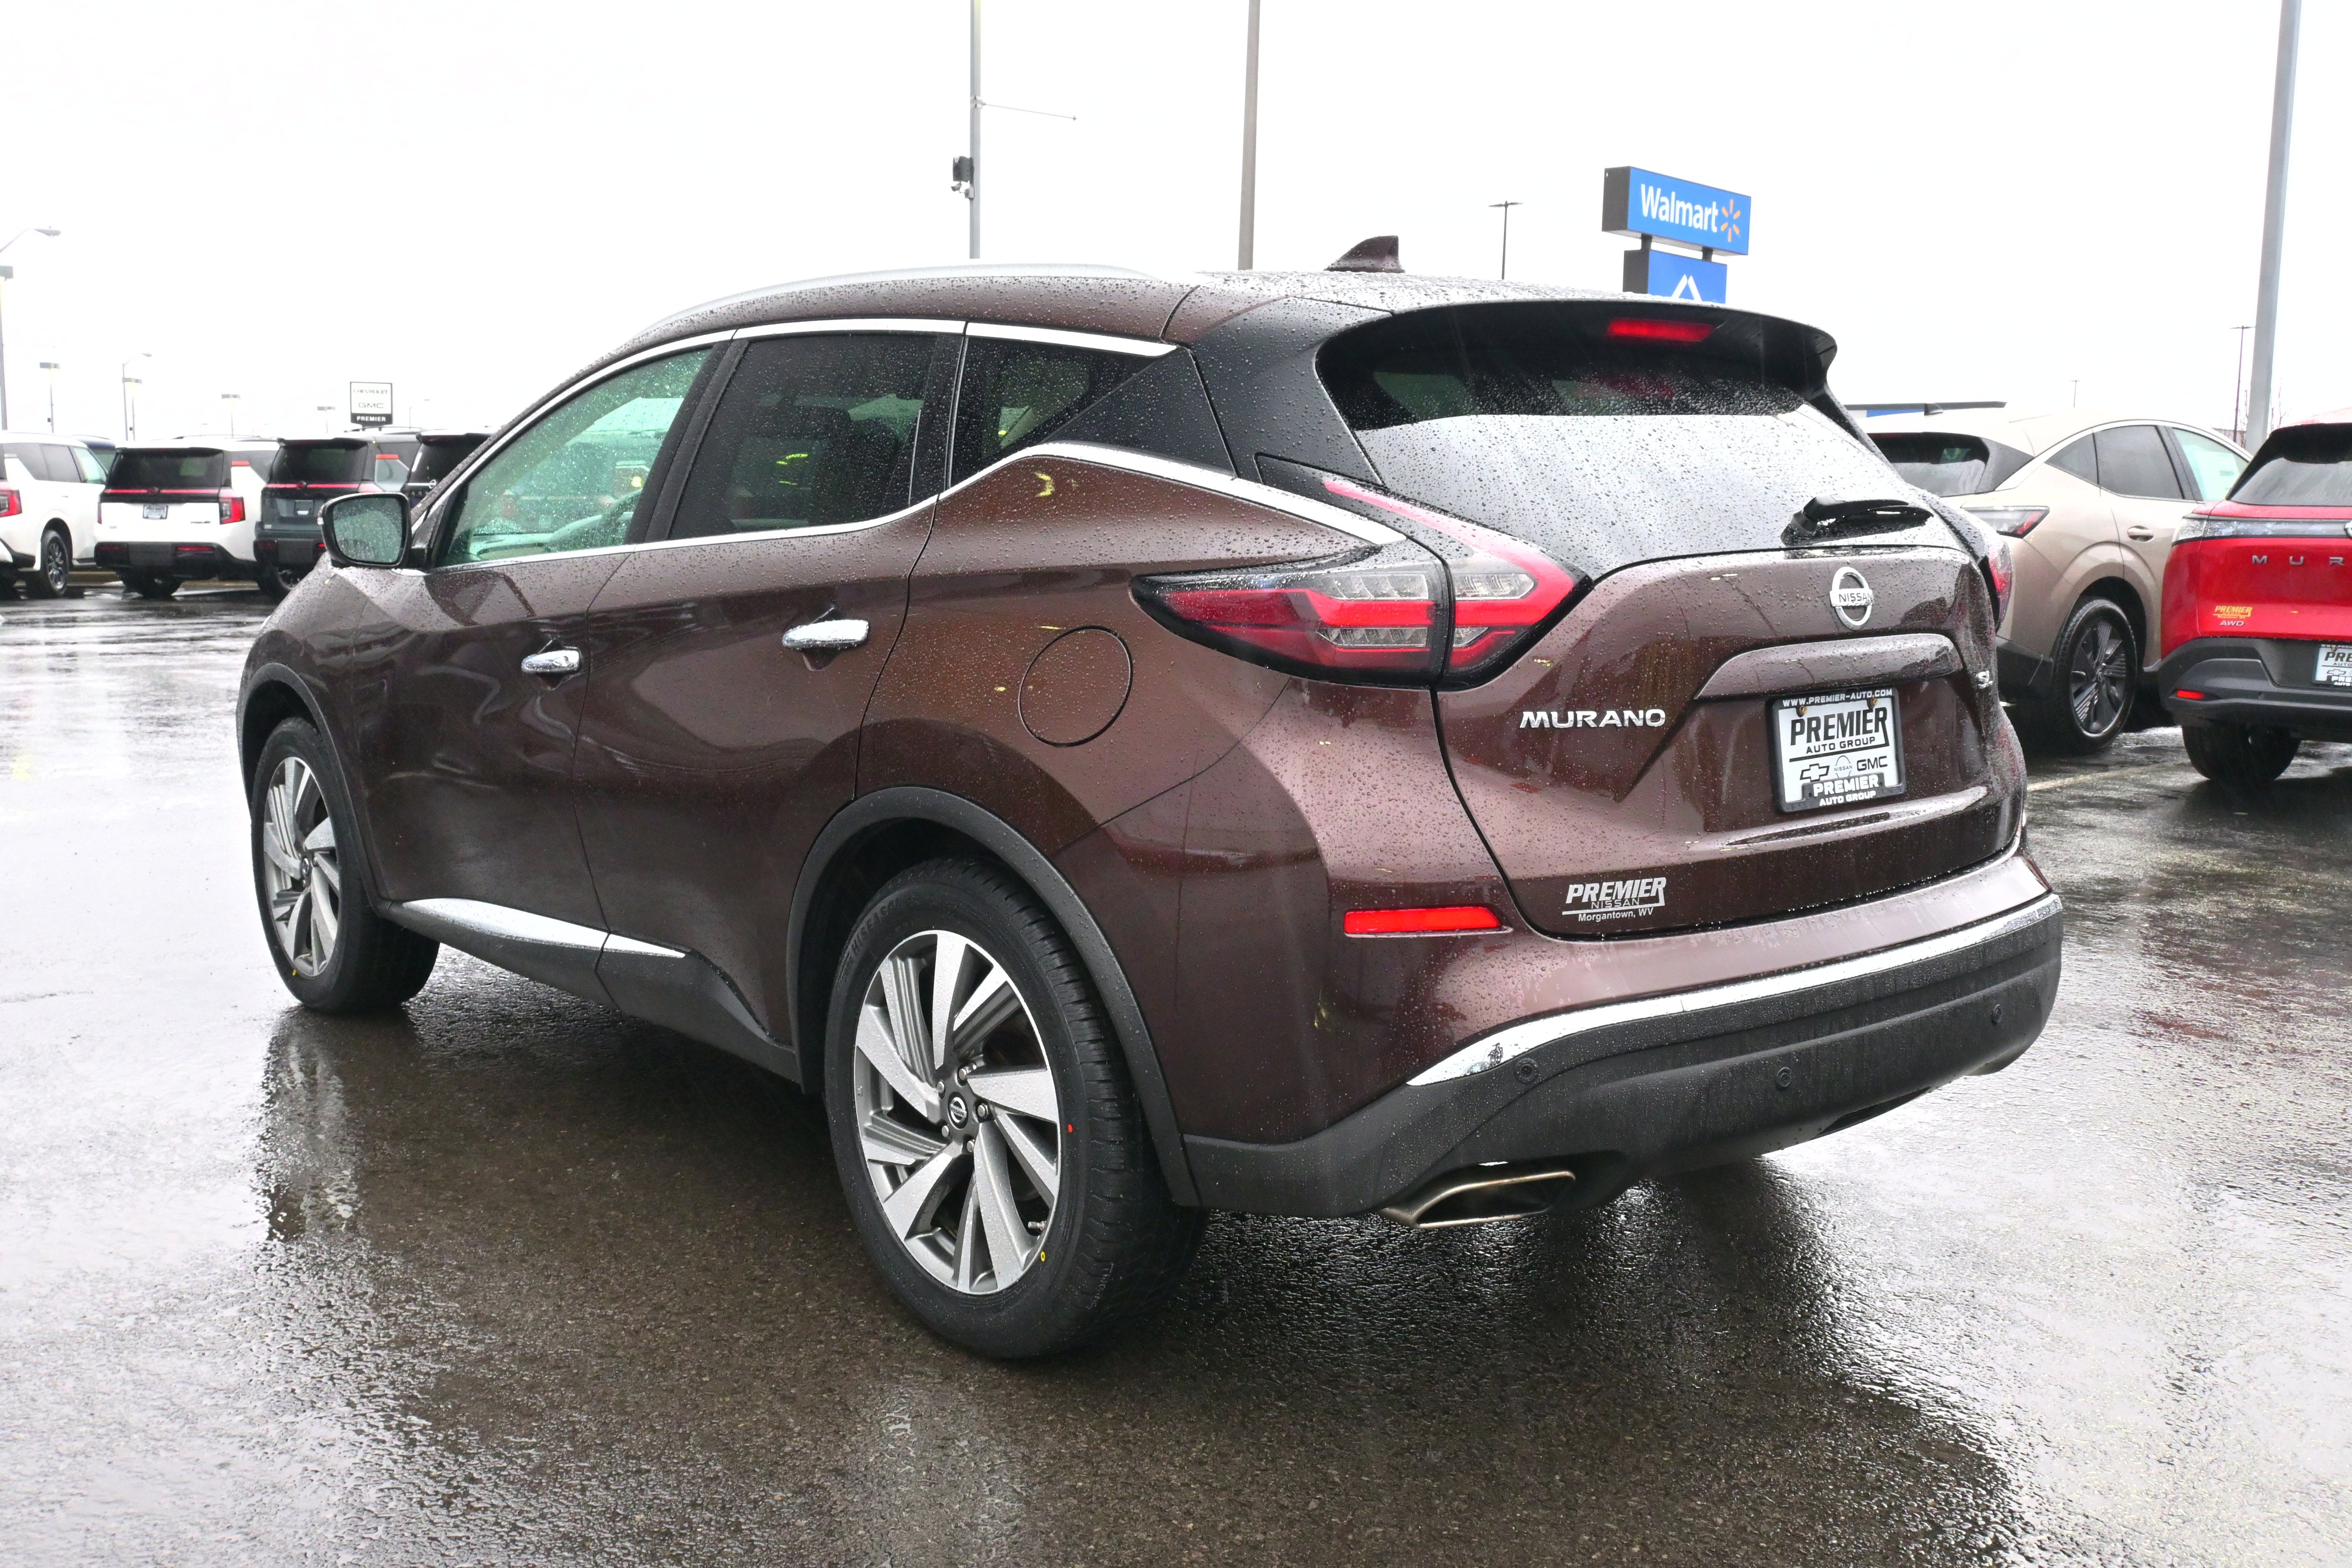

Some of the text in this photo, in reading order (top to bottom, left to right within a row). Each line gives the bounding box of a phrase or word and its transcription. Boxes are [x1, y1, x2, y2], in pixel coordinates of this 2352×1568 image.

[1641, 184, 1718, 232] Walmart
[1839, 593, 1873, 603] NISSAN
[2214, 606, 2252, 617] PREMIER
[1782, 689, 1893, 707] WWW.PREMIER-AUTO.COM
[1520, 709, 1666, 729] MURANO
[1790, 707, 1890, 747] PREMIER
[1806, 736, 1876, 754] AUTO GROUP
[1857, 755, 1888, 771] GMC
[1813, 774, 1879, 797] PREMIER
[1819, 790, 1877, 807] AUTO GROUP
[1565, 877, 1667, 906] PREMIER
[1591, 898, 1640, 909] NISSAN
[1578, 907, 1654, 923] Morgantown, WV
